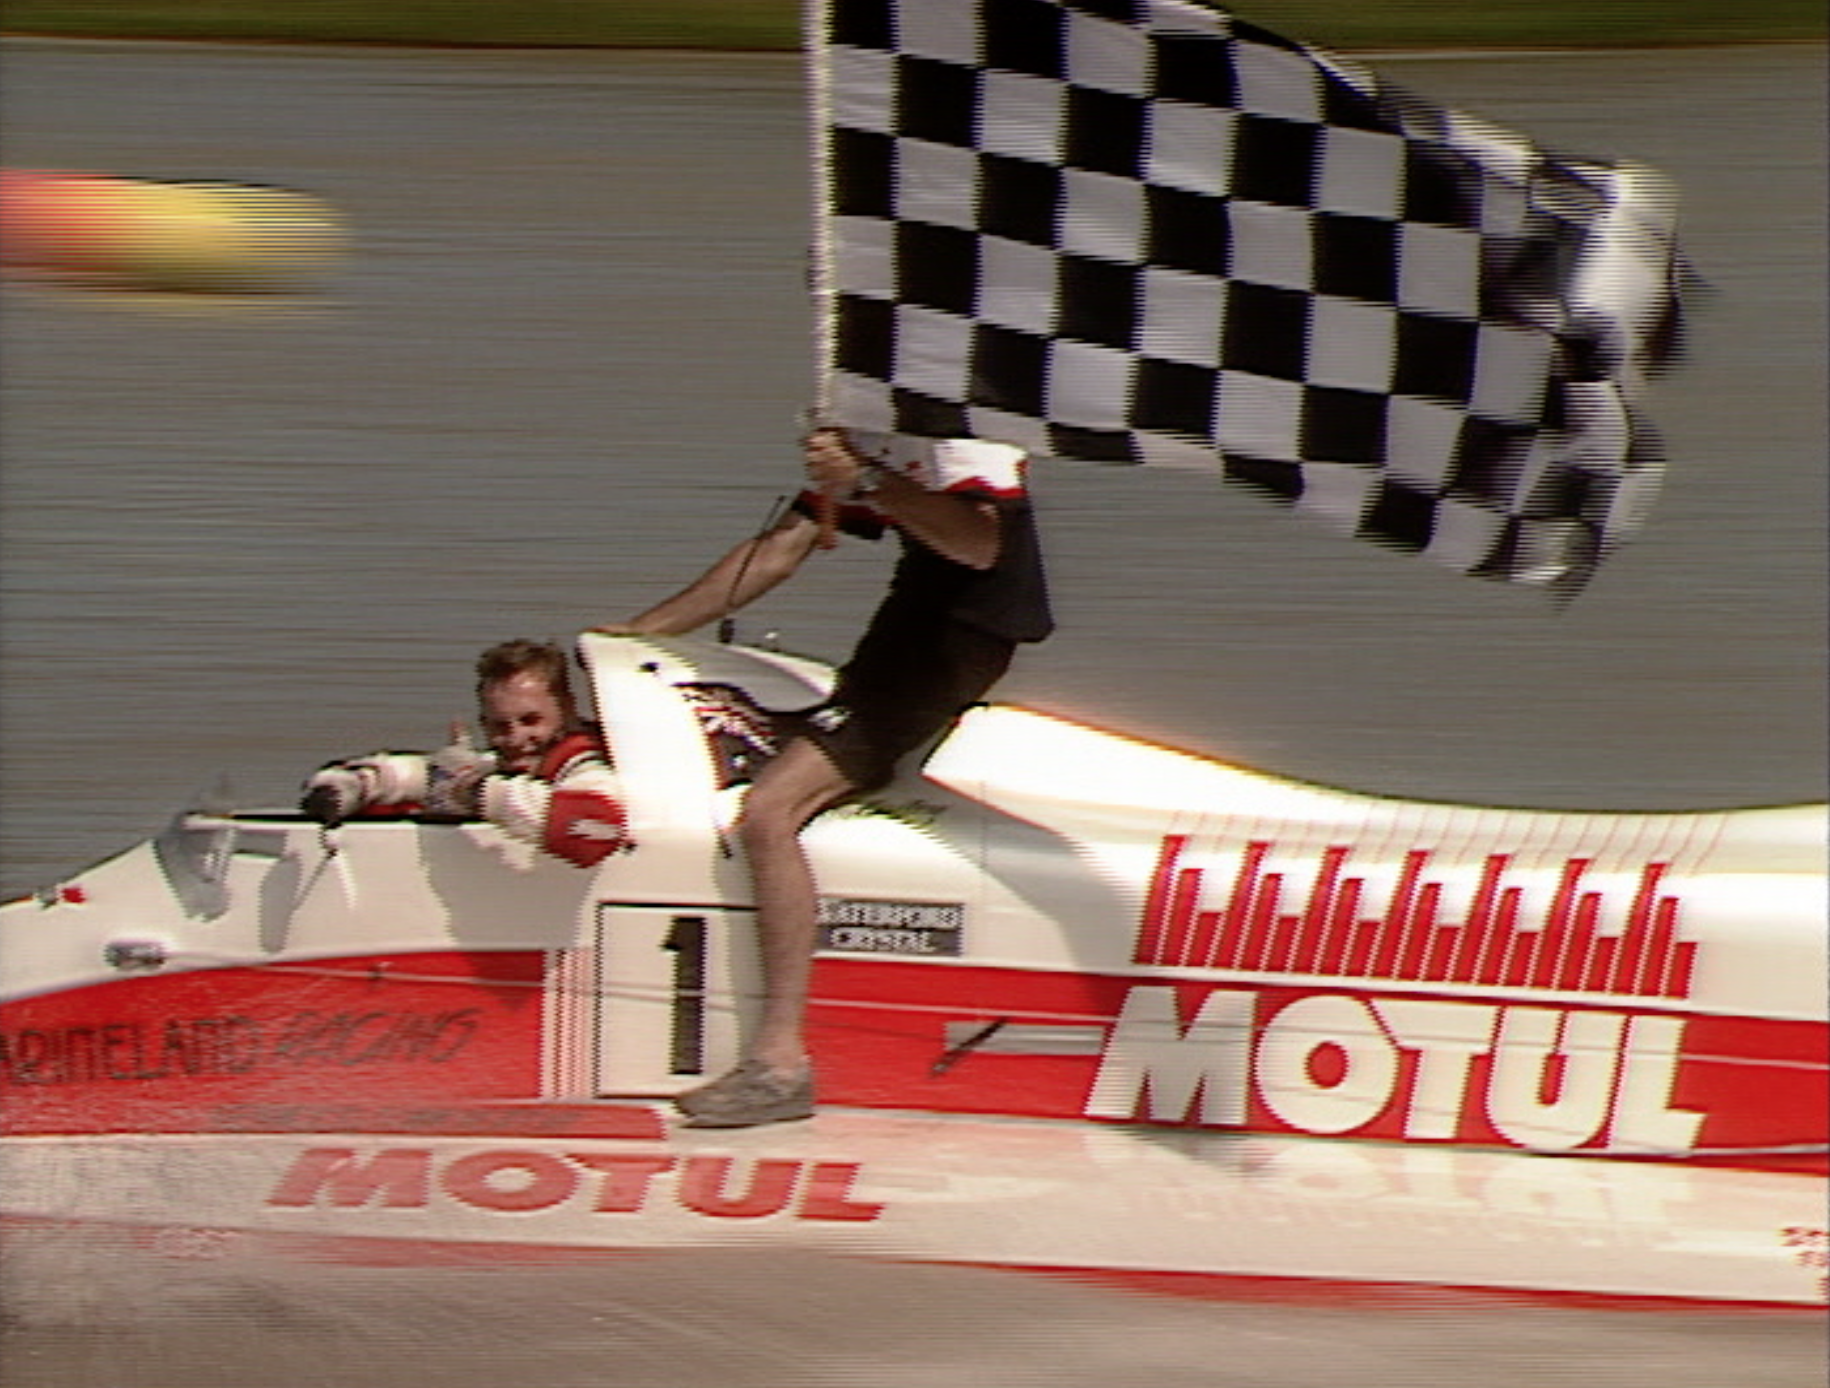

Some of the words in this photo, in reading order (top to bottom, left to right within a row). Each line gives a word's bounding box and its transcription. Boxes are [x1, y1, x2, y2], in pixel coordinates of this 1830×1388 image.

[659, 915, 706, 1074] 1
[1084, 985, 1706, 1156] MOTUL
[264, 1147, 884, 1221] MOTUL
